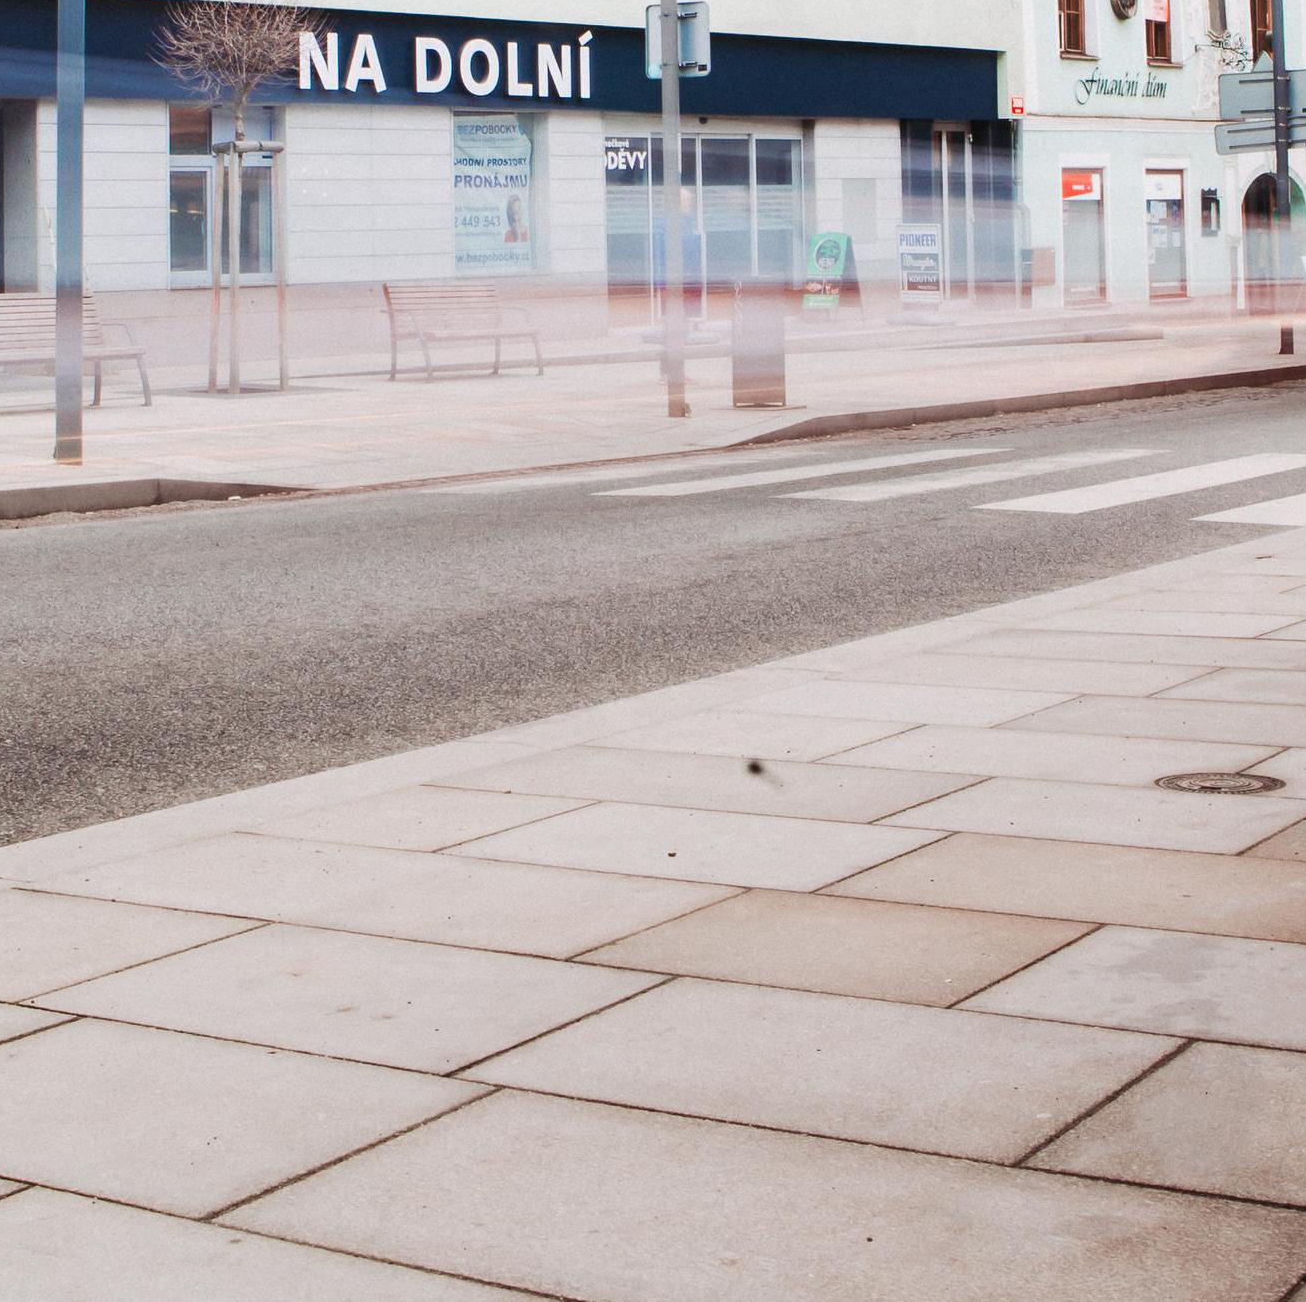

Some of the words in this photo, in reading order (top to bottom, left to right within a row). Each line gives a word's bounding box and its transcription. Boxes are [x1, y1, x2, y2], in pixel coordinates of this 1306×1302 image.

[298, 31, 387, 92] NA
[415, 29, 593, 99] DOLNÍ
[604, 148, 647, 170] DĚVY
[454, 172, 528, 188] PRONÁJMU
[899, 233, 937, 247] PIONEER
